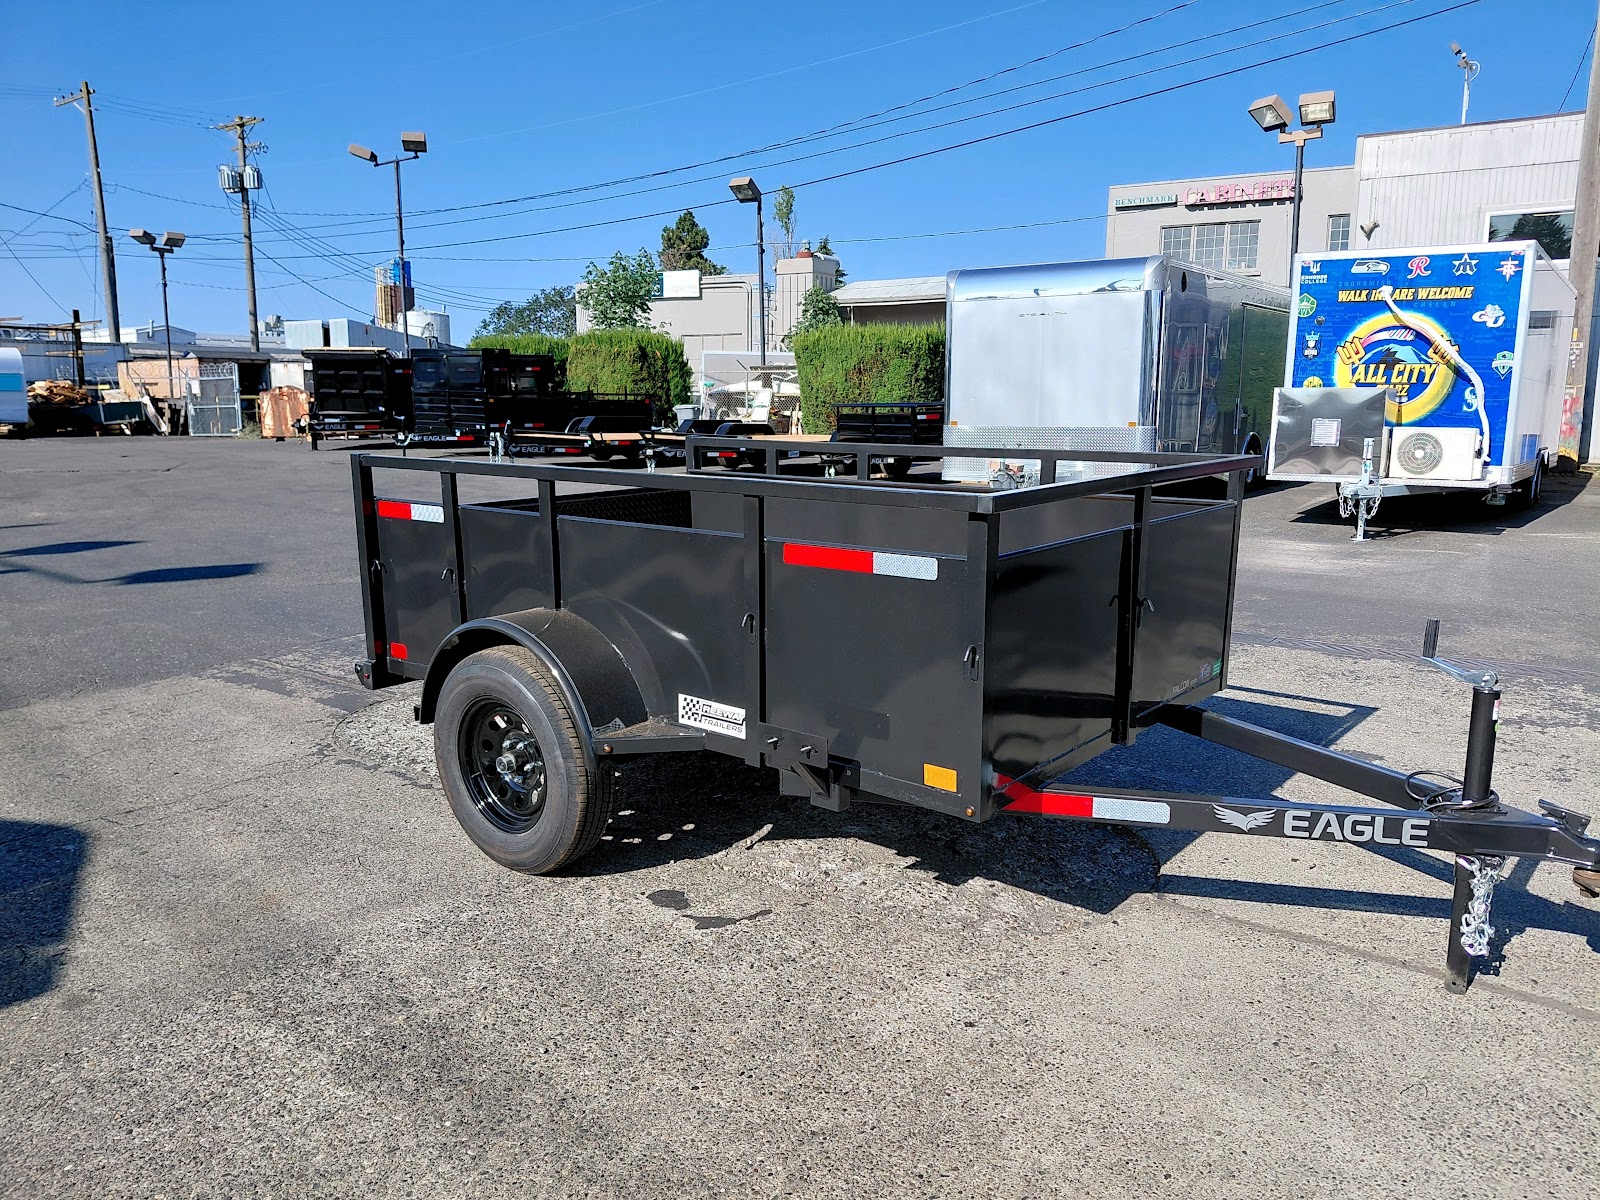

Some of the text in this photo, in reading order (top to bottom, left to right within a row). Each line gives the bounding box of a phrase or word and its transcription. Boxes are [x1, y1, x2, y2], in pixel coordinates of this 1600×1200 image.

[1115, 195, 1175, 206] BENCHMARK
[1337, 290, 1371, 302] WALK
[1391, 288, 1416, 300] ARE
[1417, 286, 1475, 300] WELCOME
[1472, 309, 1506, 328] GU
[1350, 363, 1439, 384] ALL CITY
[703, 718, 743, 733] TRAILERS
[1283, 810, 1431, 848] EAGLE
